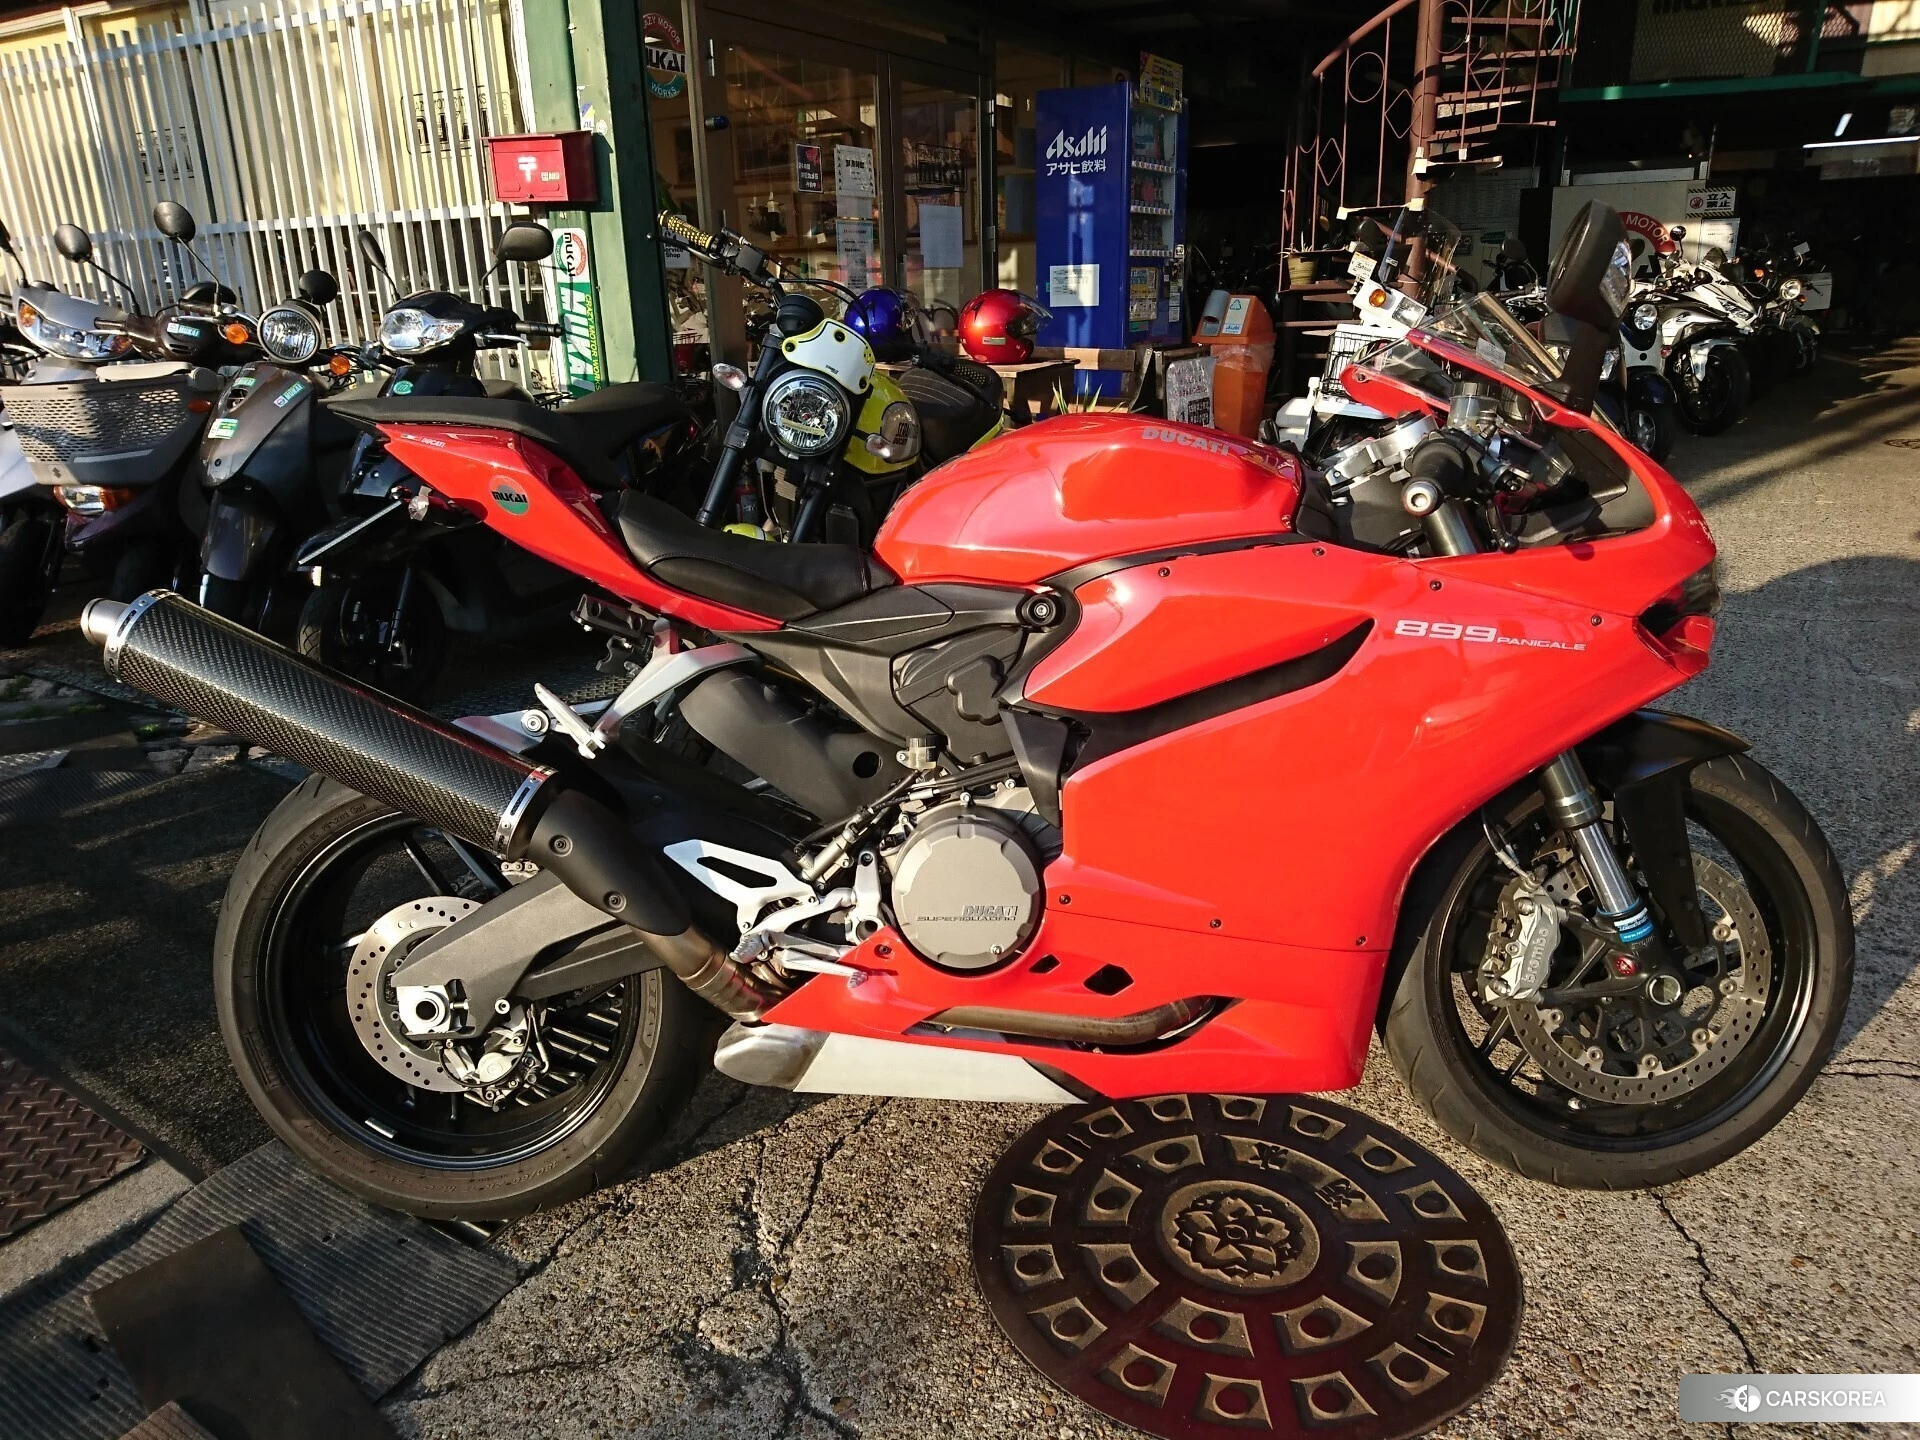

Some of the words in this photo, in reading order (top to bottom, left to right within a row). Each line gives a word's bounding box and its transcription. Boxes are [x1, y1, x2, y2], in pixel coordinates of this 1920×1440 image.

[658, 18, 681, 45] MOTOR
[646, 46, 686, 74] UKAI
[651, 82, 677, 98] WORKS
[1046, 125, 1107, 160] Asahi
[1046, 159, 1107, 176] アサヒ飲料
[1706, 193, 1731, 201] 立入
[1706, 200, 1731, 208] 禁止
[1625, 215, 1670, 246] MOTOR
[585, 293, 594, 325] CRAZY
[560, 286, 597, 392] MUKAI
[588, 326, 598, 357] MOTOR
[592, 359, 602, 391] WORKS
[1141, 427, 1230, 456] DUCATI
[1394, 619, 1497, 643] 899
[1496, 636, 1587, 651] PANIGALE
[962, 905, 1019, 917] DUCATI
[1521, 927, 1550, 984] brembo
